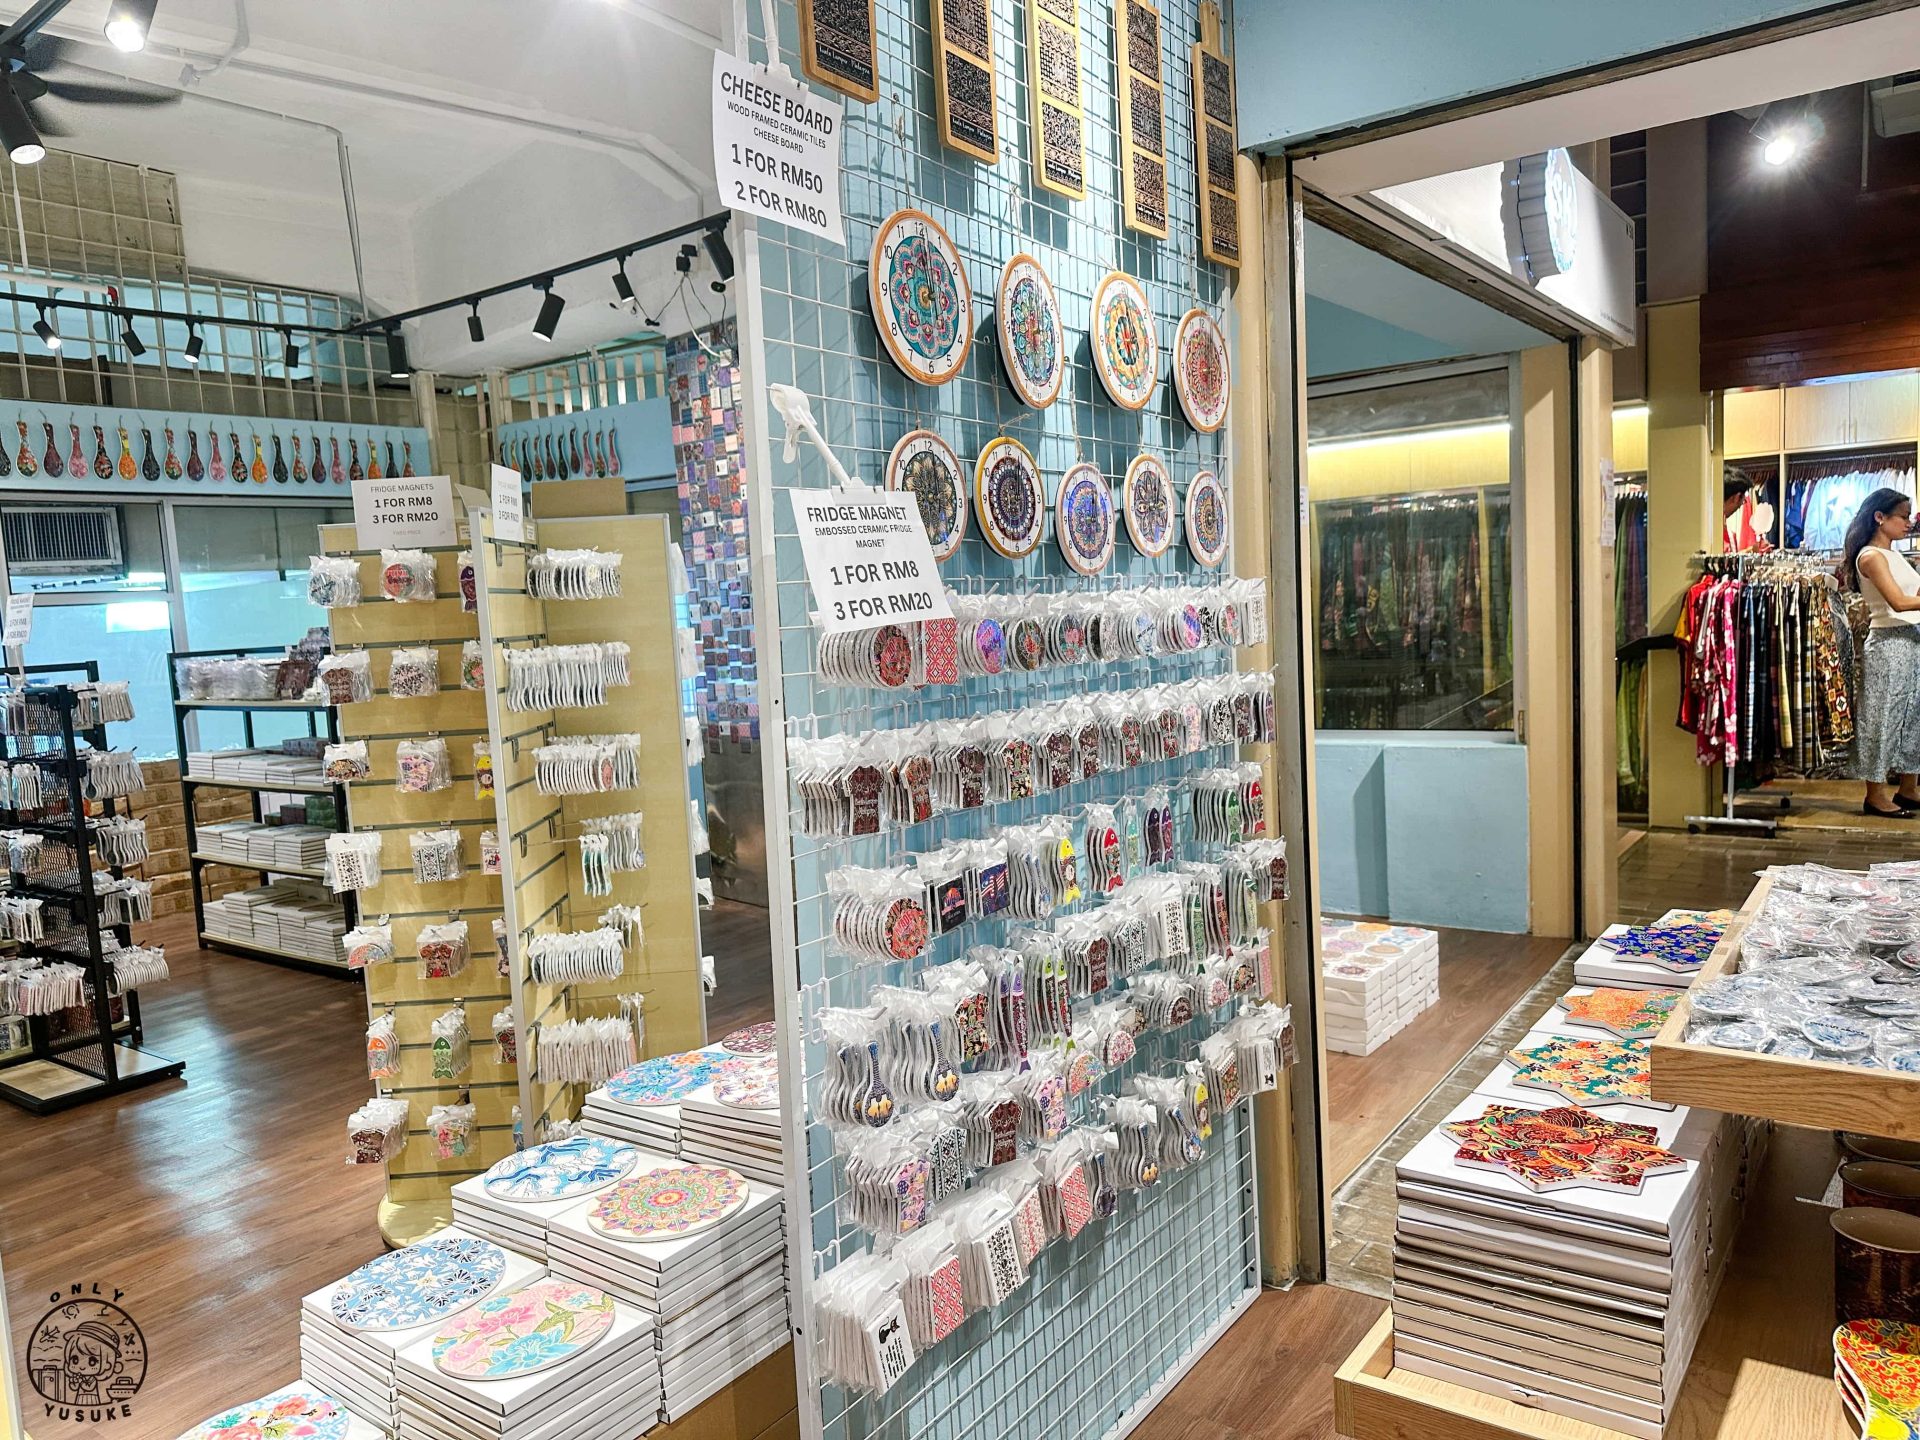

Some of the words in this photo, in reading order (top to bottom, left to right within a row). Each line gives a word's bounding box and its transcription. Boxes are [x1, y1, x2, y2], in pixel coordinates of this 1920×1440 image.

[721, 72, 781, 114] CHEESE
[785, 100, 832, 134] BOARD
[728, 102, 749, 117] WOOD
[752, 111, 778, 129] FRAMED
[780, 123, 809, 142] CERAMIC
[810, 135, 826, 148] TILES
[754, 128, 779, 145] CHEESE
[781, 139, 803, 153] BOARD
[732, 144, 741, 164] 1
[745, 148, 777, 177] FOR
[781, 162, 822, 193] RM50
[735, 181, 746, 200] 2
[749, 185, 782, 213] FOR
[785, 198, 826, 228] RM80
[897, 225, 904, 238] 11
[915, 222, 924, 237] 12
[938, 236, 941, 248] 1
[884, 245, 892, 259] 10
[952, 263, 957, 276] 2
[882, 283, 887, 296] 9
[961, 300, 965, 313] 3
[1143, 309, 1147, 319] 2
[1200, 319, 1205, 328] 12
[892, 323, 897, 336] 8
[958, 334, 963, 344] 4
[1100, 335, 1104, 346] 9
[908, 349, 913, 361] 7
[1220, 346, 1222, 355] 2
[947, 355, 952, 367] 5
[929, 361, 934, 373] 6
[1107, 366, 1111, 376] 8
[1181, 363, 1184, 372] 9
[1049, 382, 1052, 392] 5
[1118, 385, 1122, 394] 7
[1143, 384, 1146, 393] 5
[1132, 391, 1135, 401] 6
[1186, 390, 1189, 400] 8
[1216, 412, 1218, 420] 5
[910, 444, 916, 453] 11
[924, 441, 932, 451] 12
[1005, 446, 1011, 455] 12
[993, 451, 998, 461] 11
[898, 460, 905, 470] 10
[953, 470, 957, 480] 2
[984, 468, 990, 478] 10
[1031, 469, 1035, 478] 2
[1083, 472, 1088, 480] 12
[370, 485, 395, 493] FRIDGE
[983, 494, 987, 503] 9
[1037, 493, 1041, 503] 3
[1104, 492, 1107, 500] 2
[375, 500, 381, 508] 1
[384, 498, 405, 507] FOR
[408, 497, 432, 506] RM8
[959, 499, 963, 508] 3
[373, 515, 379, 524] 3
[382, 514, 404, 523] FOR
[407, 512, 438, 522] RM20
[807, 507, 857, 522] FRIDGE
[860, 507, 907, 521] MAGNET
[1064, 516, 1067, 524] 9
[1109, 516, 1112, 524] 3
[815, 525, 856, 536] EMBOSSED
[859, 525, 889, 534] CERAMIC
[890, 525, 912, 533] FRIDGE
[955, 524, 959, 532] 4
[990, 521, 994, 530] 8
[856, 539, 885, 548] MAGNET
[945, 541, 949, 550] 5
[1001, 537, 1005, 545] 7
[1028, 536, 1032, 545] 5
[1069, 540, 1072, 549] 8
[1015, 542, 1019, 551] 6
[1078, 555, 1081, 563] 7
[1100, 553, 1103, 561] 5
[1089, 560, 1093, 568] 6
[830, 566, 842, 586] 1
[845, 562, 881, 584] FOR
[884, 560, 919, 580] RM8
[834, 602, 845, 621] 3
[850, 597, 887, 619] FOR
[888, 592, 932, 616] RM20
